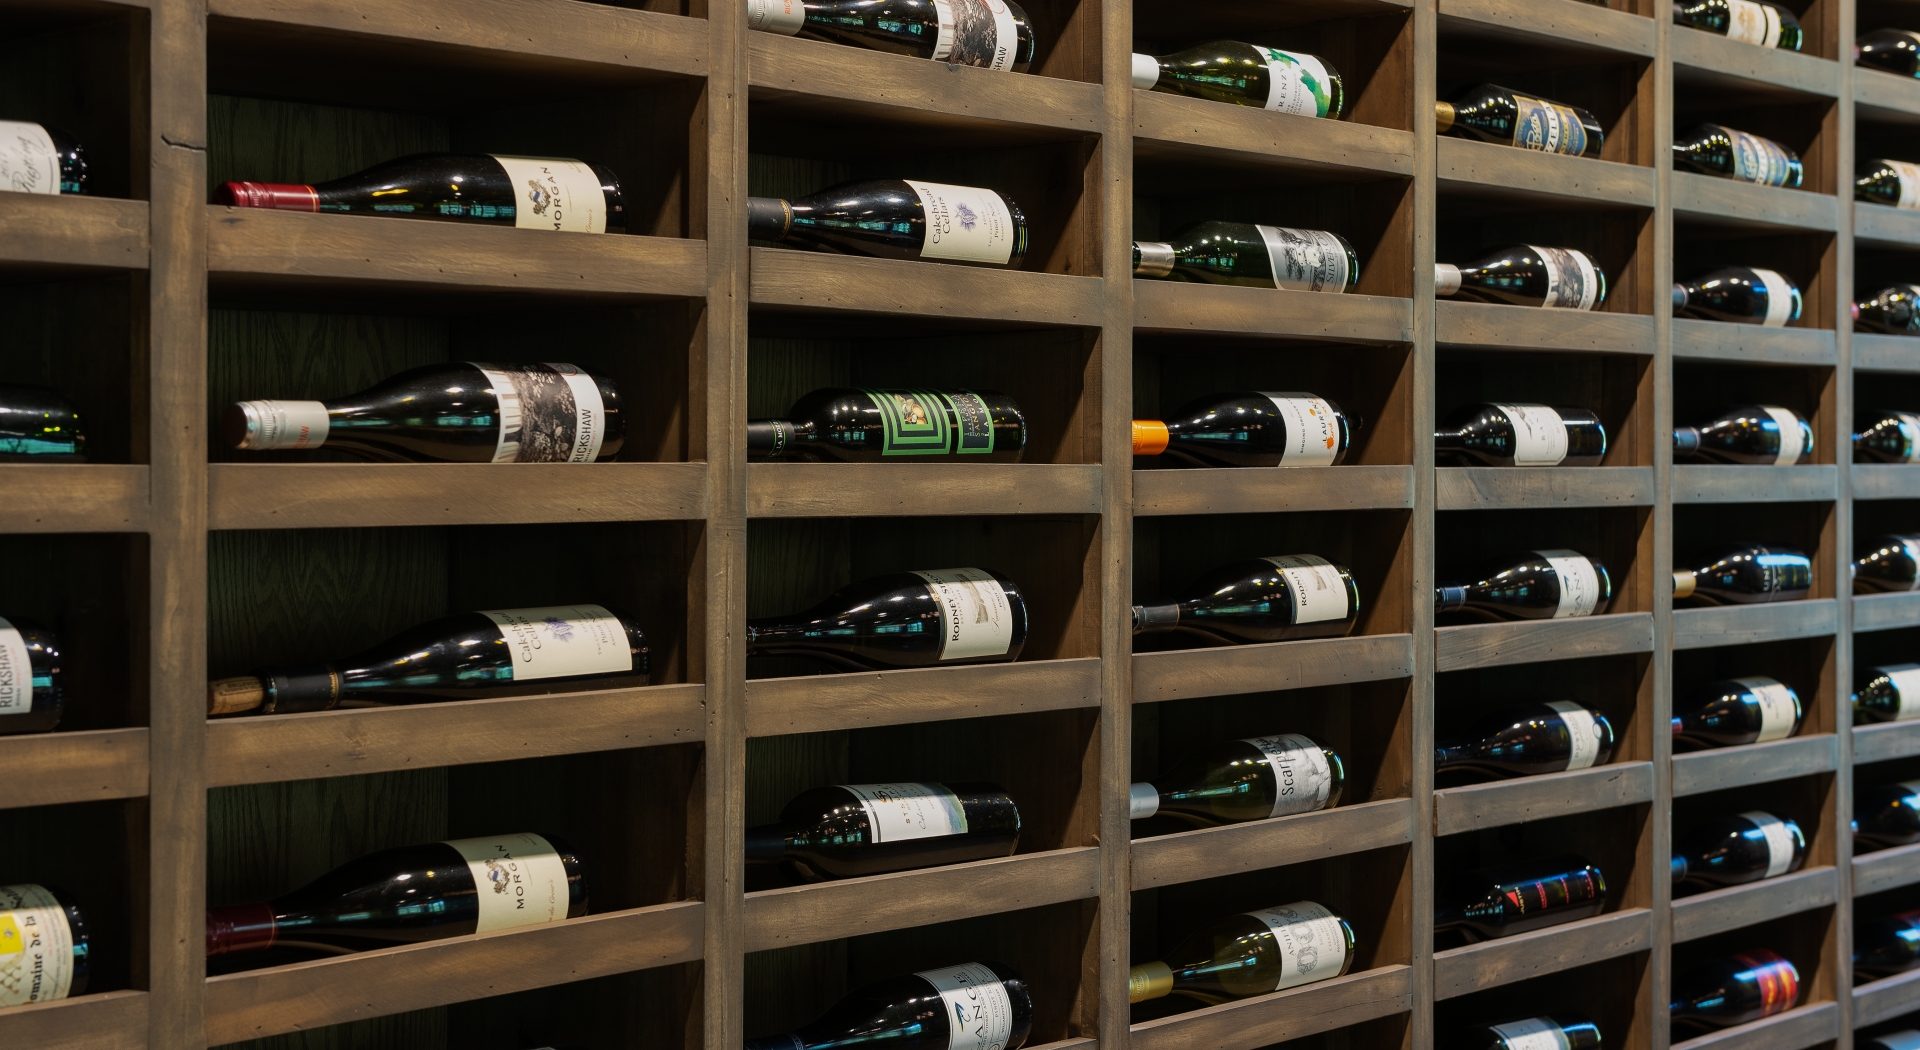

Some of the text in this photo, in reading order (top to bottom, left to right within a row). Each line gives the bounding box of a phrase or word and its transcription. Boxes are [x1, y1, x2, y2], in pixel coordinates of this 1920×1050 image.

[540, 167, 562, 230] MORGAN
[920, 188, 951, 244] Cakebread Cellars
[1326, 247, 1335, 283] SILVER
[573, 409, 592, 462] RICKSHAW
[494, 612, 542, 662] Cakebread Cellars
[947, 597, 960, 641] RODNEY
[0, 644, 13, 708] RICKSHAW
[495, 845, 525, 909] MORGAN
[1515, 886, 1525, 914] JUSTIN
[30, 933, 41, 949] de
[30, 954, 42, 1002] omaine
